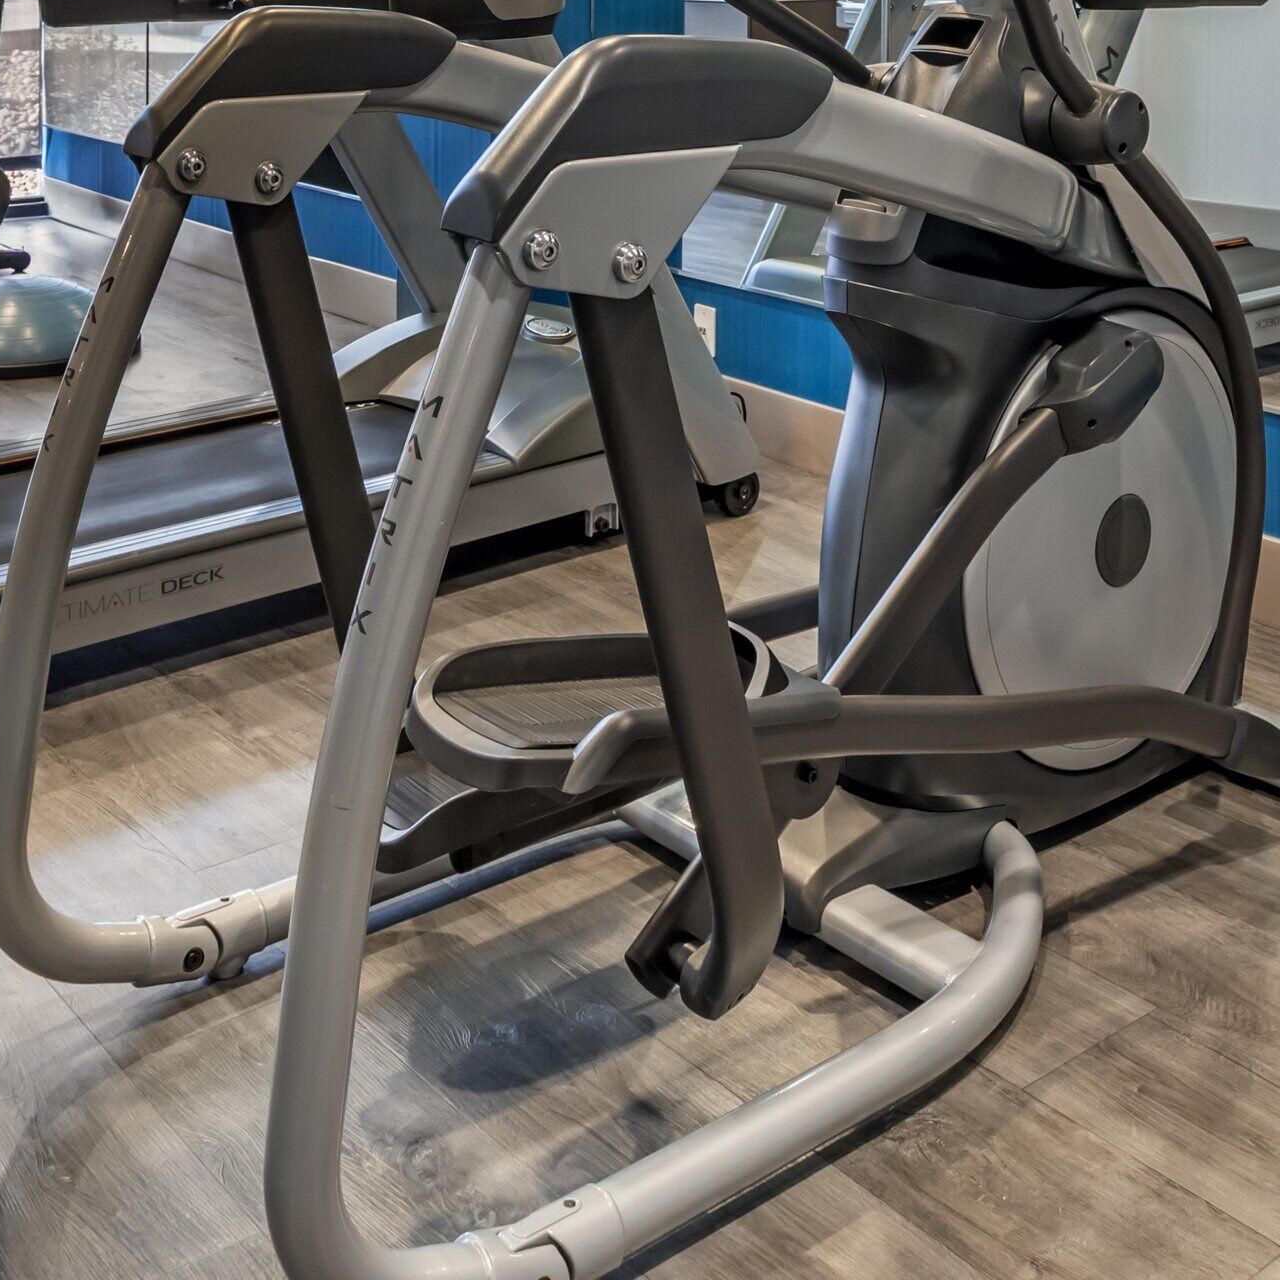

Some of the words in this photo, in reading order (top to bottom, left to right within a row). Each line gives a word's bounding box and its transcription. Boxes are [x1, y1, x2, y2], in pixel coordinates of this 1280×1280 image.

[352, 395, 444, 635] MATRIX
[56, 582, 154, 627] TIMATE
[160, 566, 224, 595] DECK
